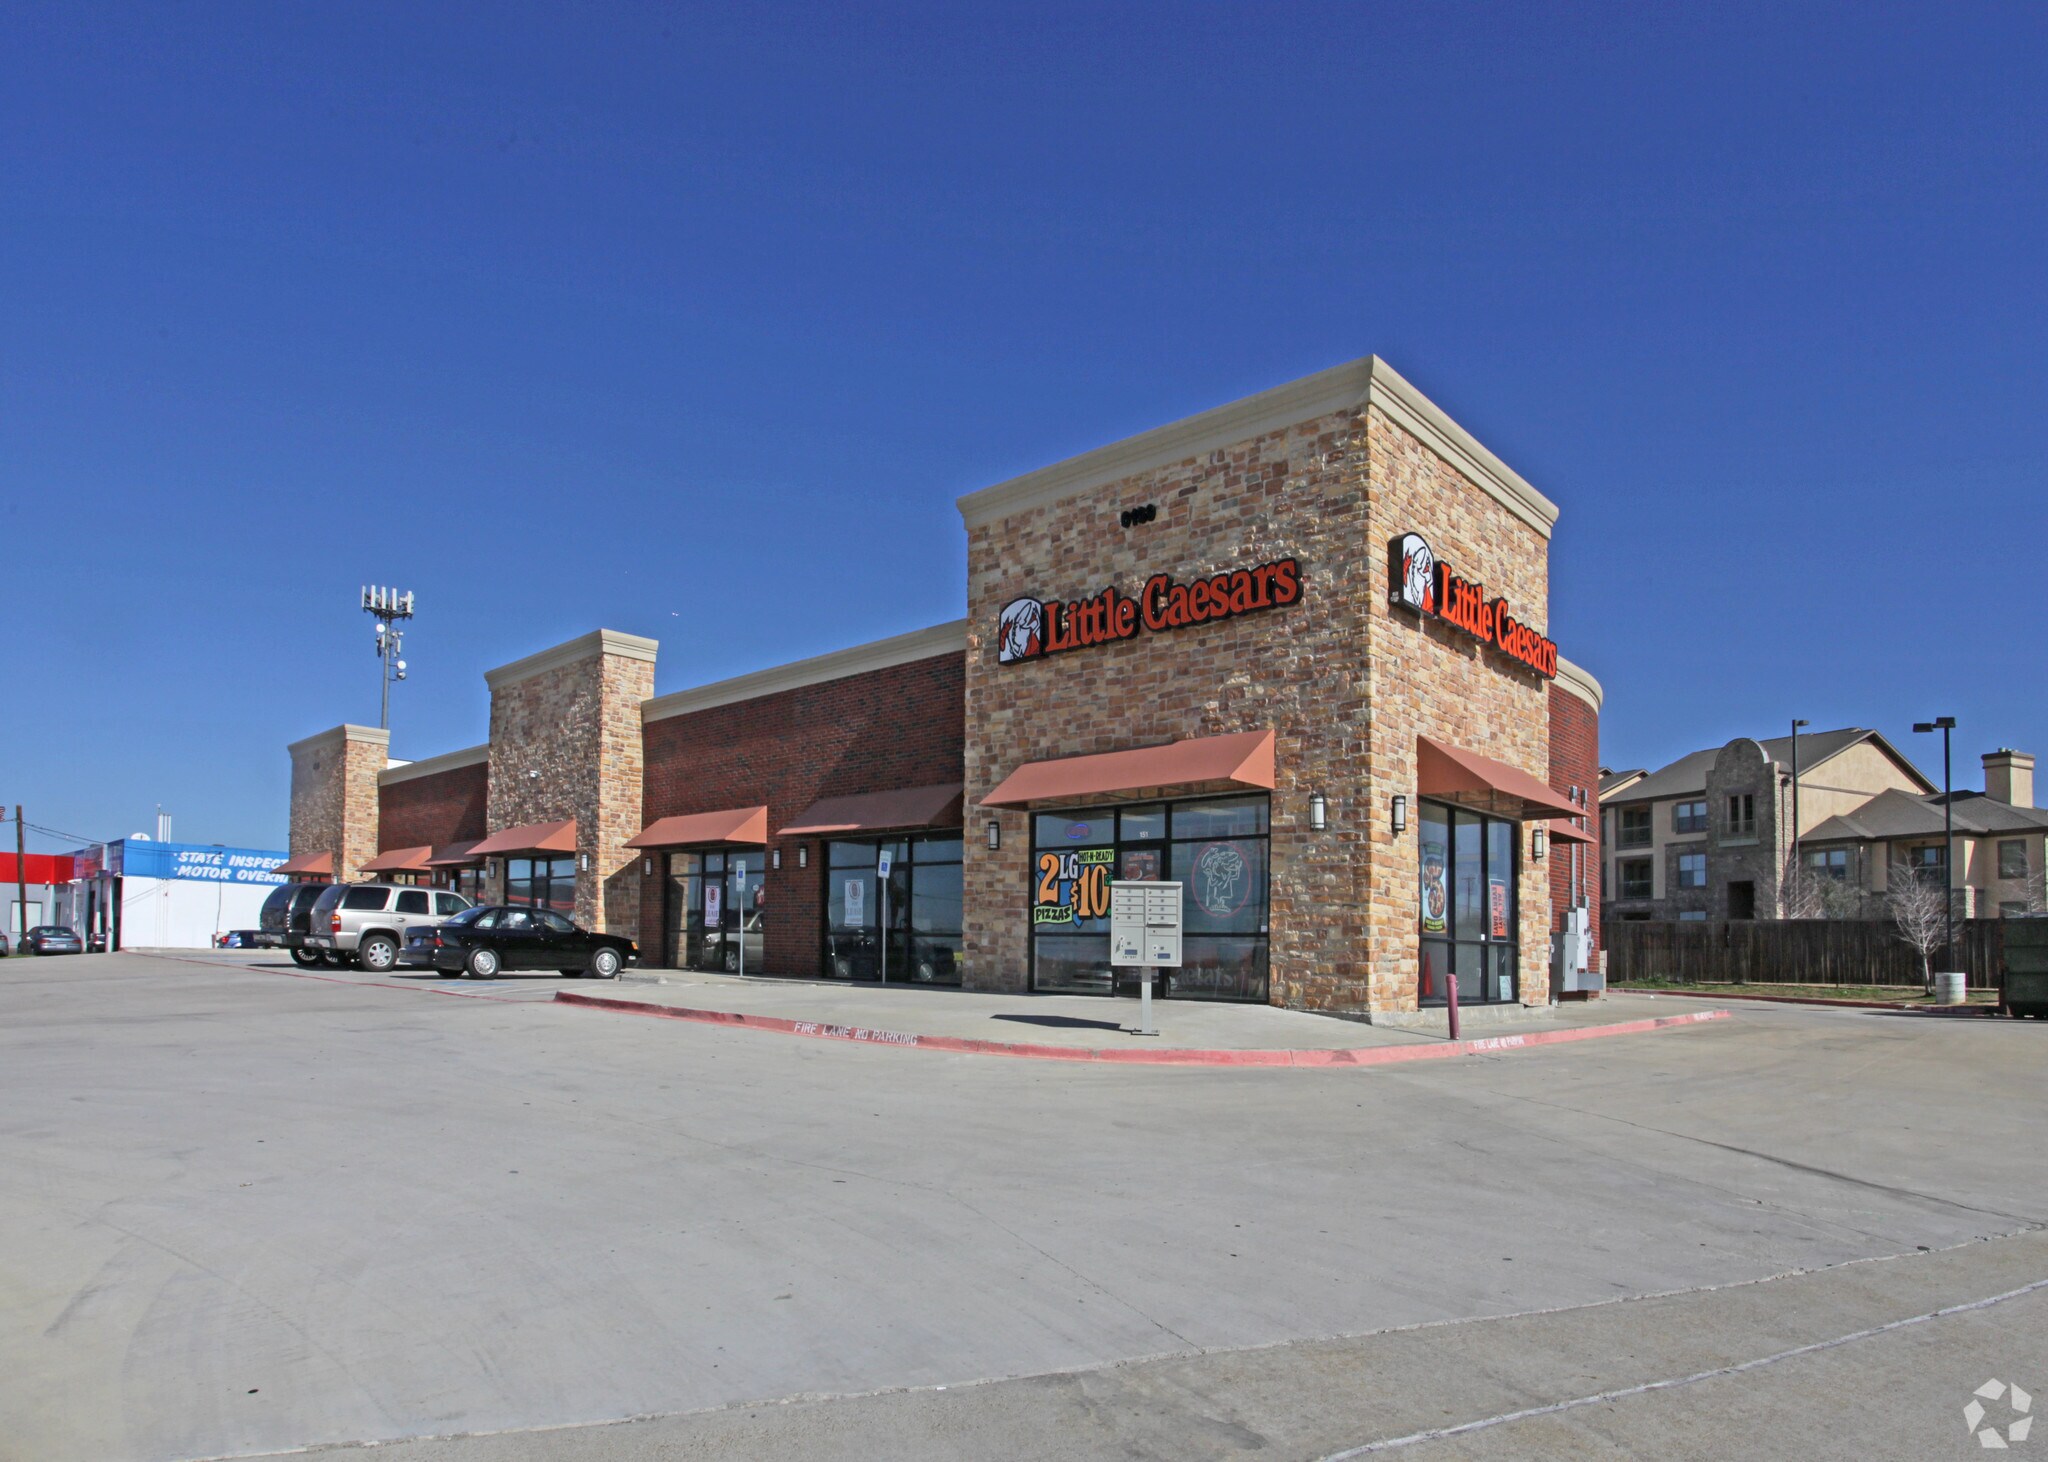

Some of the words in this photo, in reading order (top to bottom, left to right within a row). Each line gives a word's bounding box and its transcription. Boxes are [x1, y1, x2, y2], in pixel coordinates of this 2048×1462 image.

[1044, 587, 1135, 653] Little
[1141, 559, 1298, 630] Caesars
[1440, 563, 1493, 642] Little
[1495, 599, 1557, 679] Caesars
[177, 851, 225, 865] STATE
[177, 865, 232, 880] MOTOR
[1039, 853, 1060, 904] 2
[1058, 853, 1078, 879] LG
[1035, 907, 1071, 921] PIZZAS
[793, 1022, 818, 1035] FIRE
[822, 1024, 851, 1038] LANE
[854, 1028, 868, 1040] NO
[872, 1030, 918, 1046] PARKING
